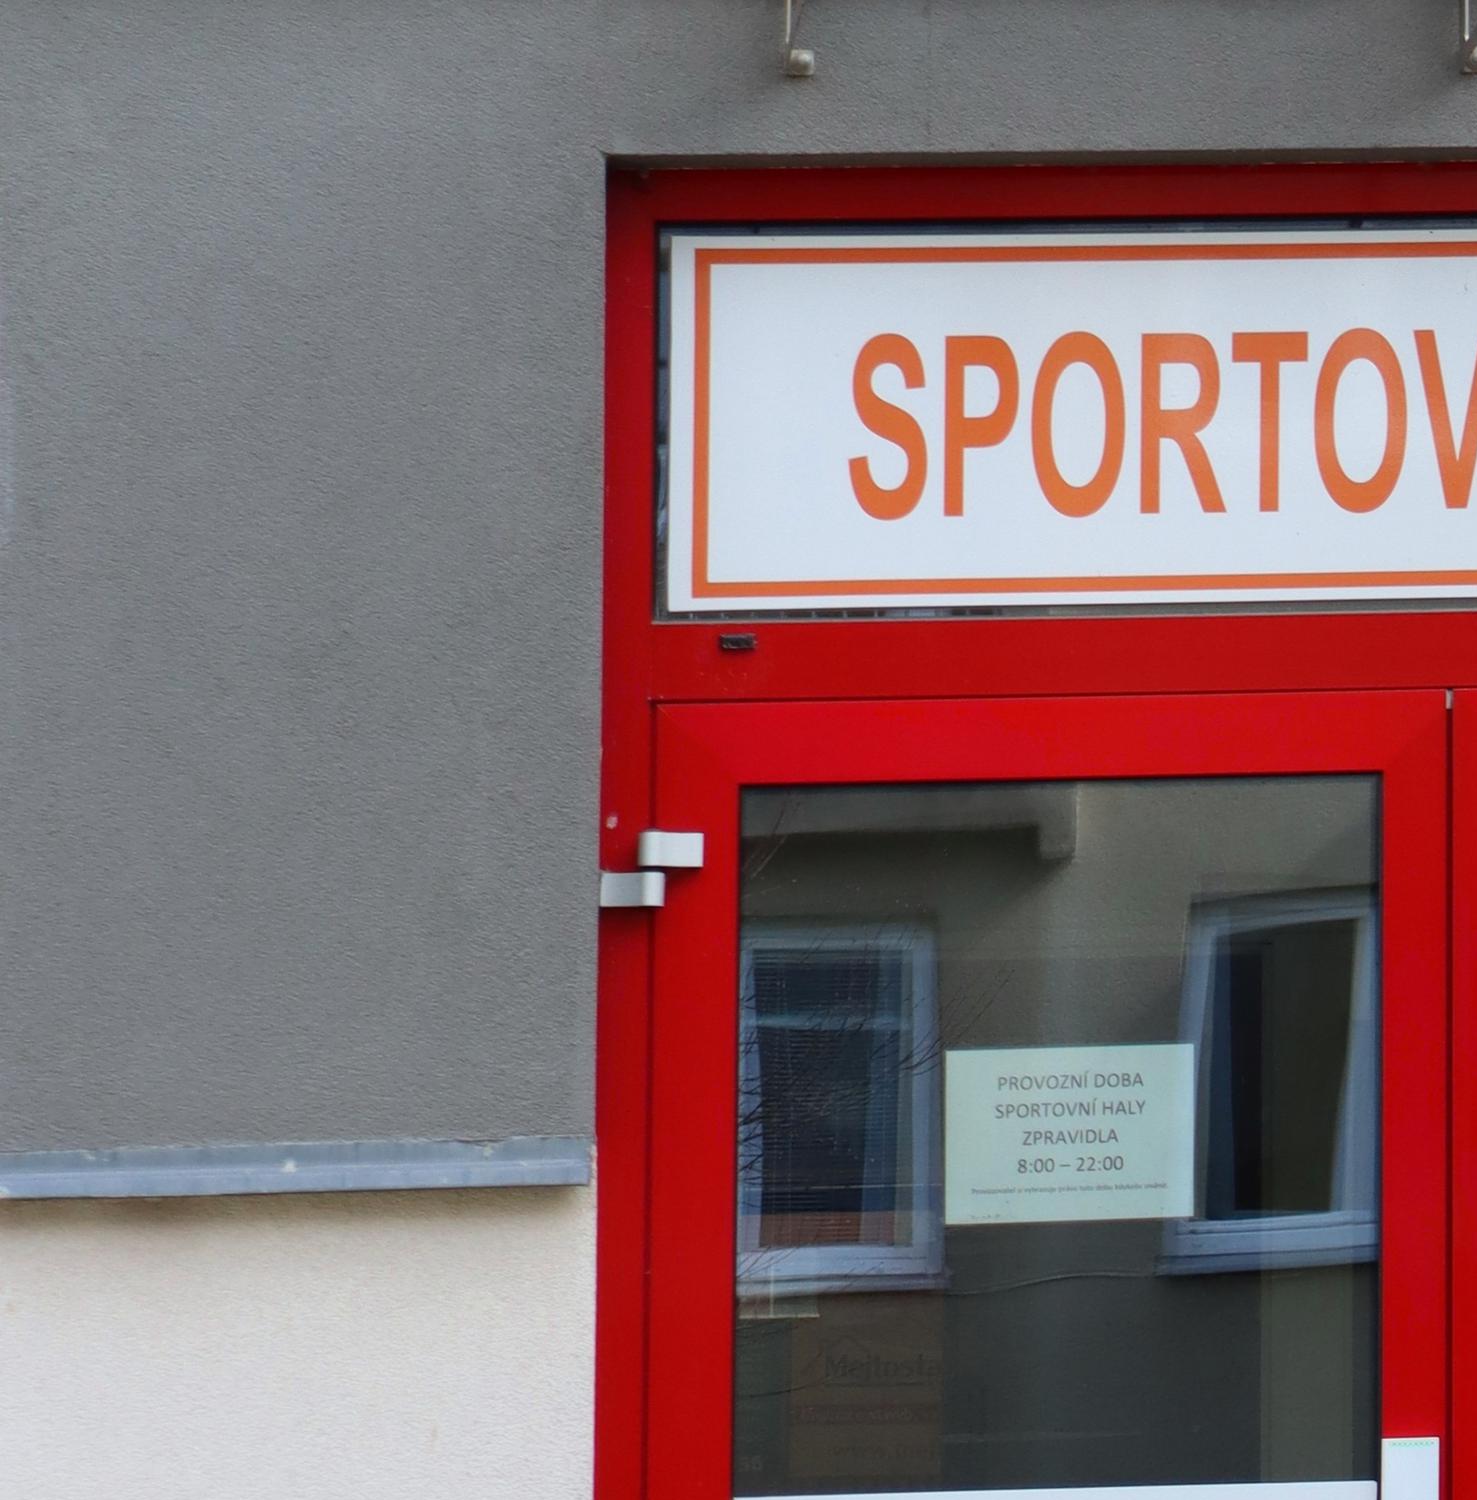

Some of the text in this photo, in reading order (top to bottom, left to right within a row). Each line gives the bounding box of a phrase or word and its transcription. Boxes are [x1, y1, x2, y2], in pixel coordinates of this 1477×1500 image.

[997, 1070, 1144, 1091] PROVOZNÍ DOBA
[994, 1098, 1146, 1119] SPORTOVNÍ HALY
[1022, 1128, 1119, 1146] ZPRAVIDLA
[1017, 1157, 1055, 1174] 8:00
[1076, 1155, 1124, 1172] 22:00
